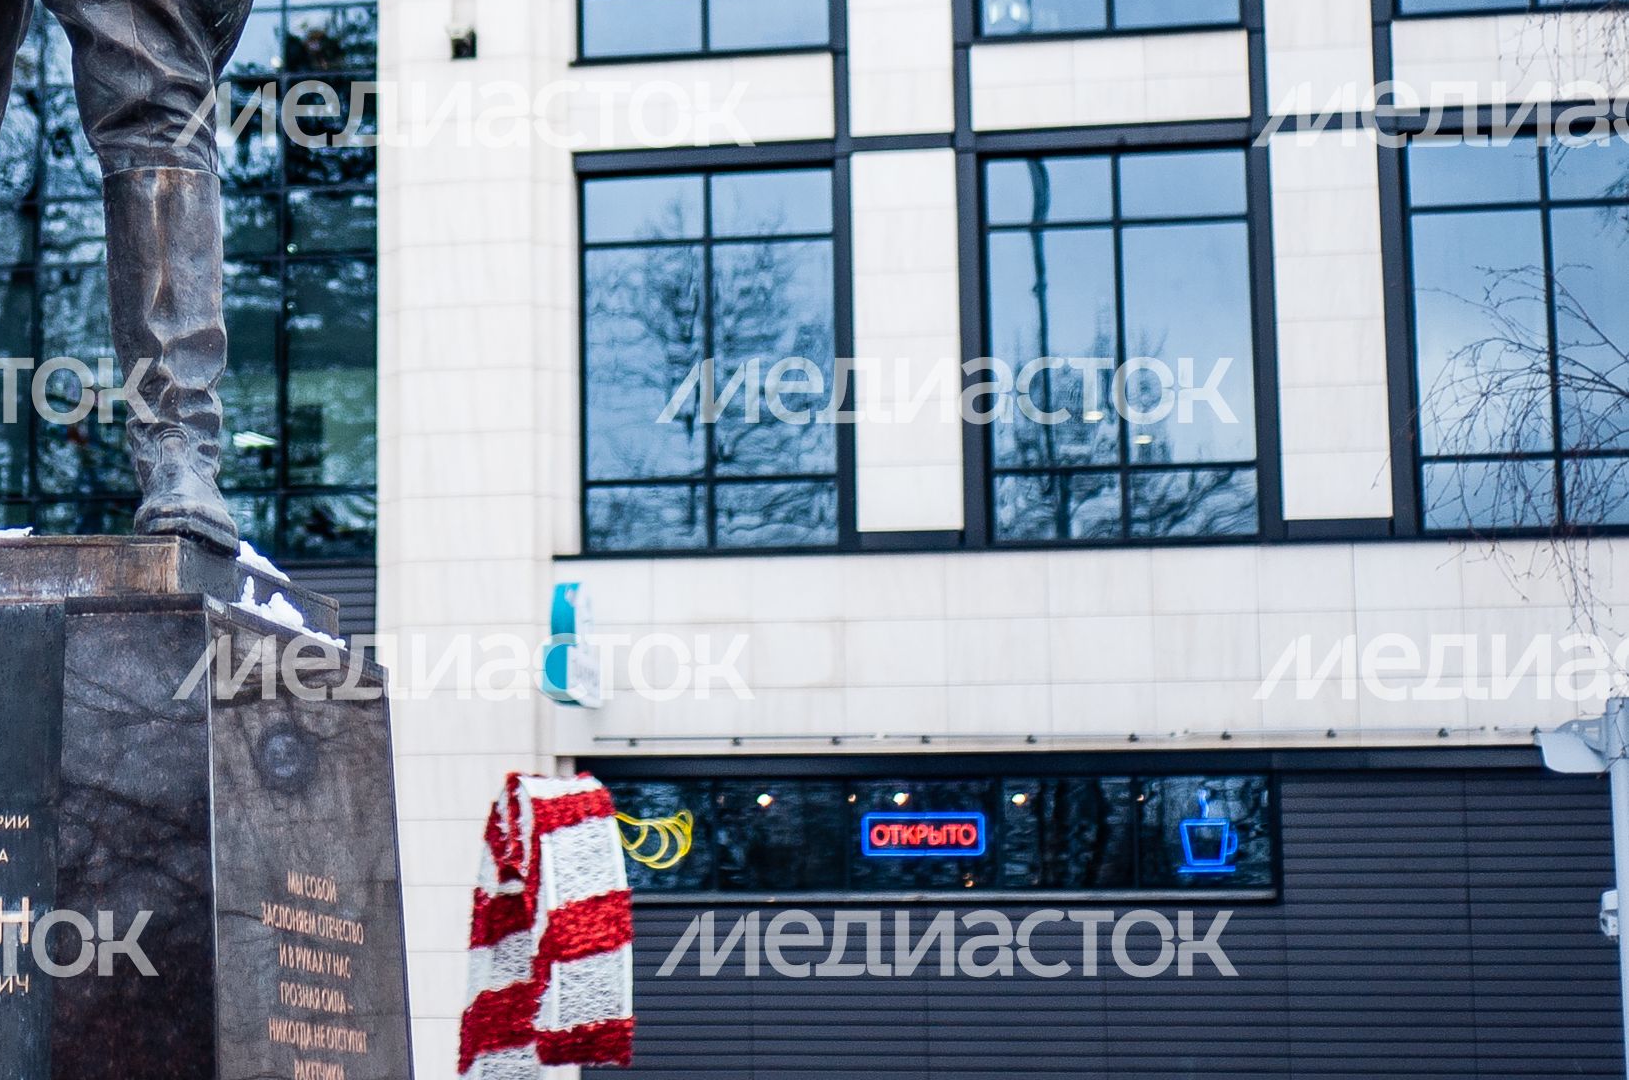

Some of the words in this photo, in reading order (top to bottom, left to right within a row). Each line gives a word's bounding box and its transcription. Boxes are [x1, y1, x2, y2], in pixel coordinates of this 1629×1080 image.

[871, 824, 977, 846] ОТКРЫТО
[288, 870, 303, 895] МЫ
[305, 875, 337, 903] СОБОЙ
[261, 901, 316, 936] ЗАСЛОНЯЕМ
[317, 914, 364, 945] ОТЕЧЕСТВО
[279, 943, 287, 966] И
[288, 946, 295, 968] В
[296, 946, 324, 974] РУКАХ
[333, 954, 352, 979] НАС
[280, 981, 320, 1010] ГРОЗНАЯ
[321, 989, 347, 1014] СИЛА
[268, 1018, 312, 1050] НИКОГДА
[314, 1024, 326, 1049] НЕ
